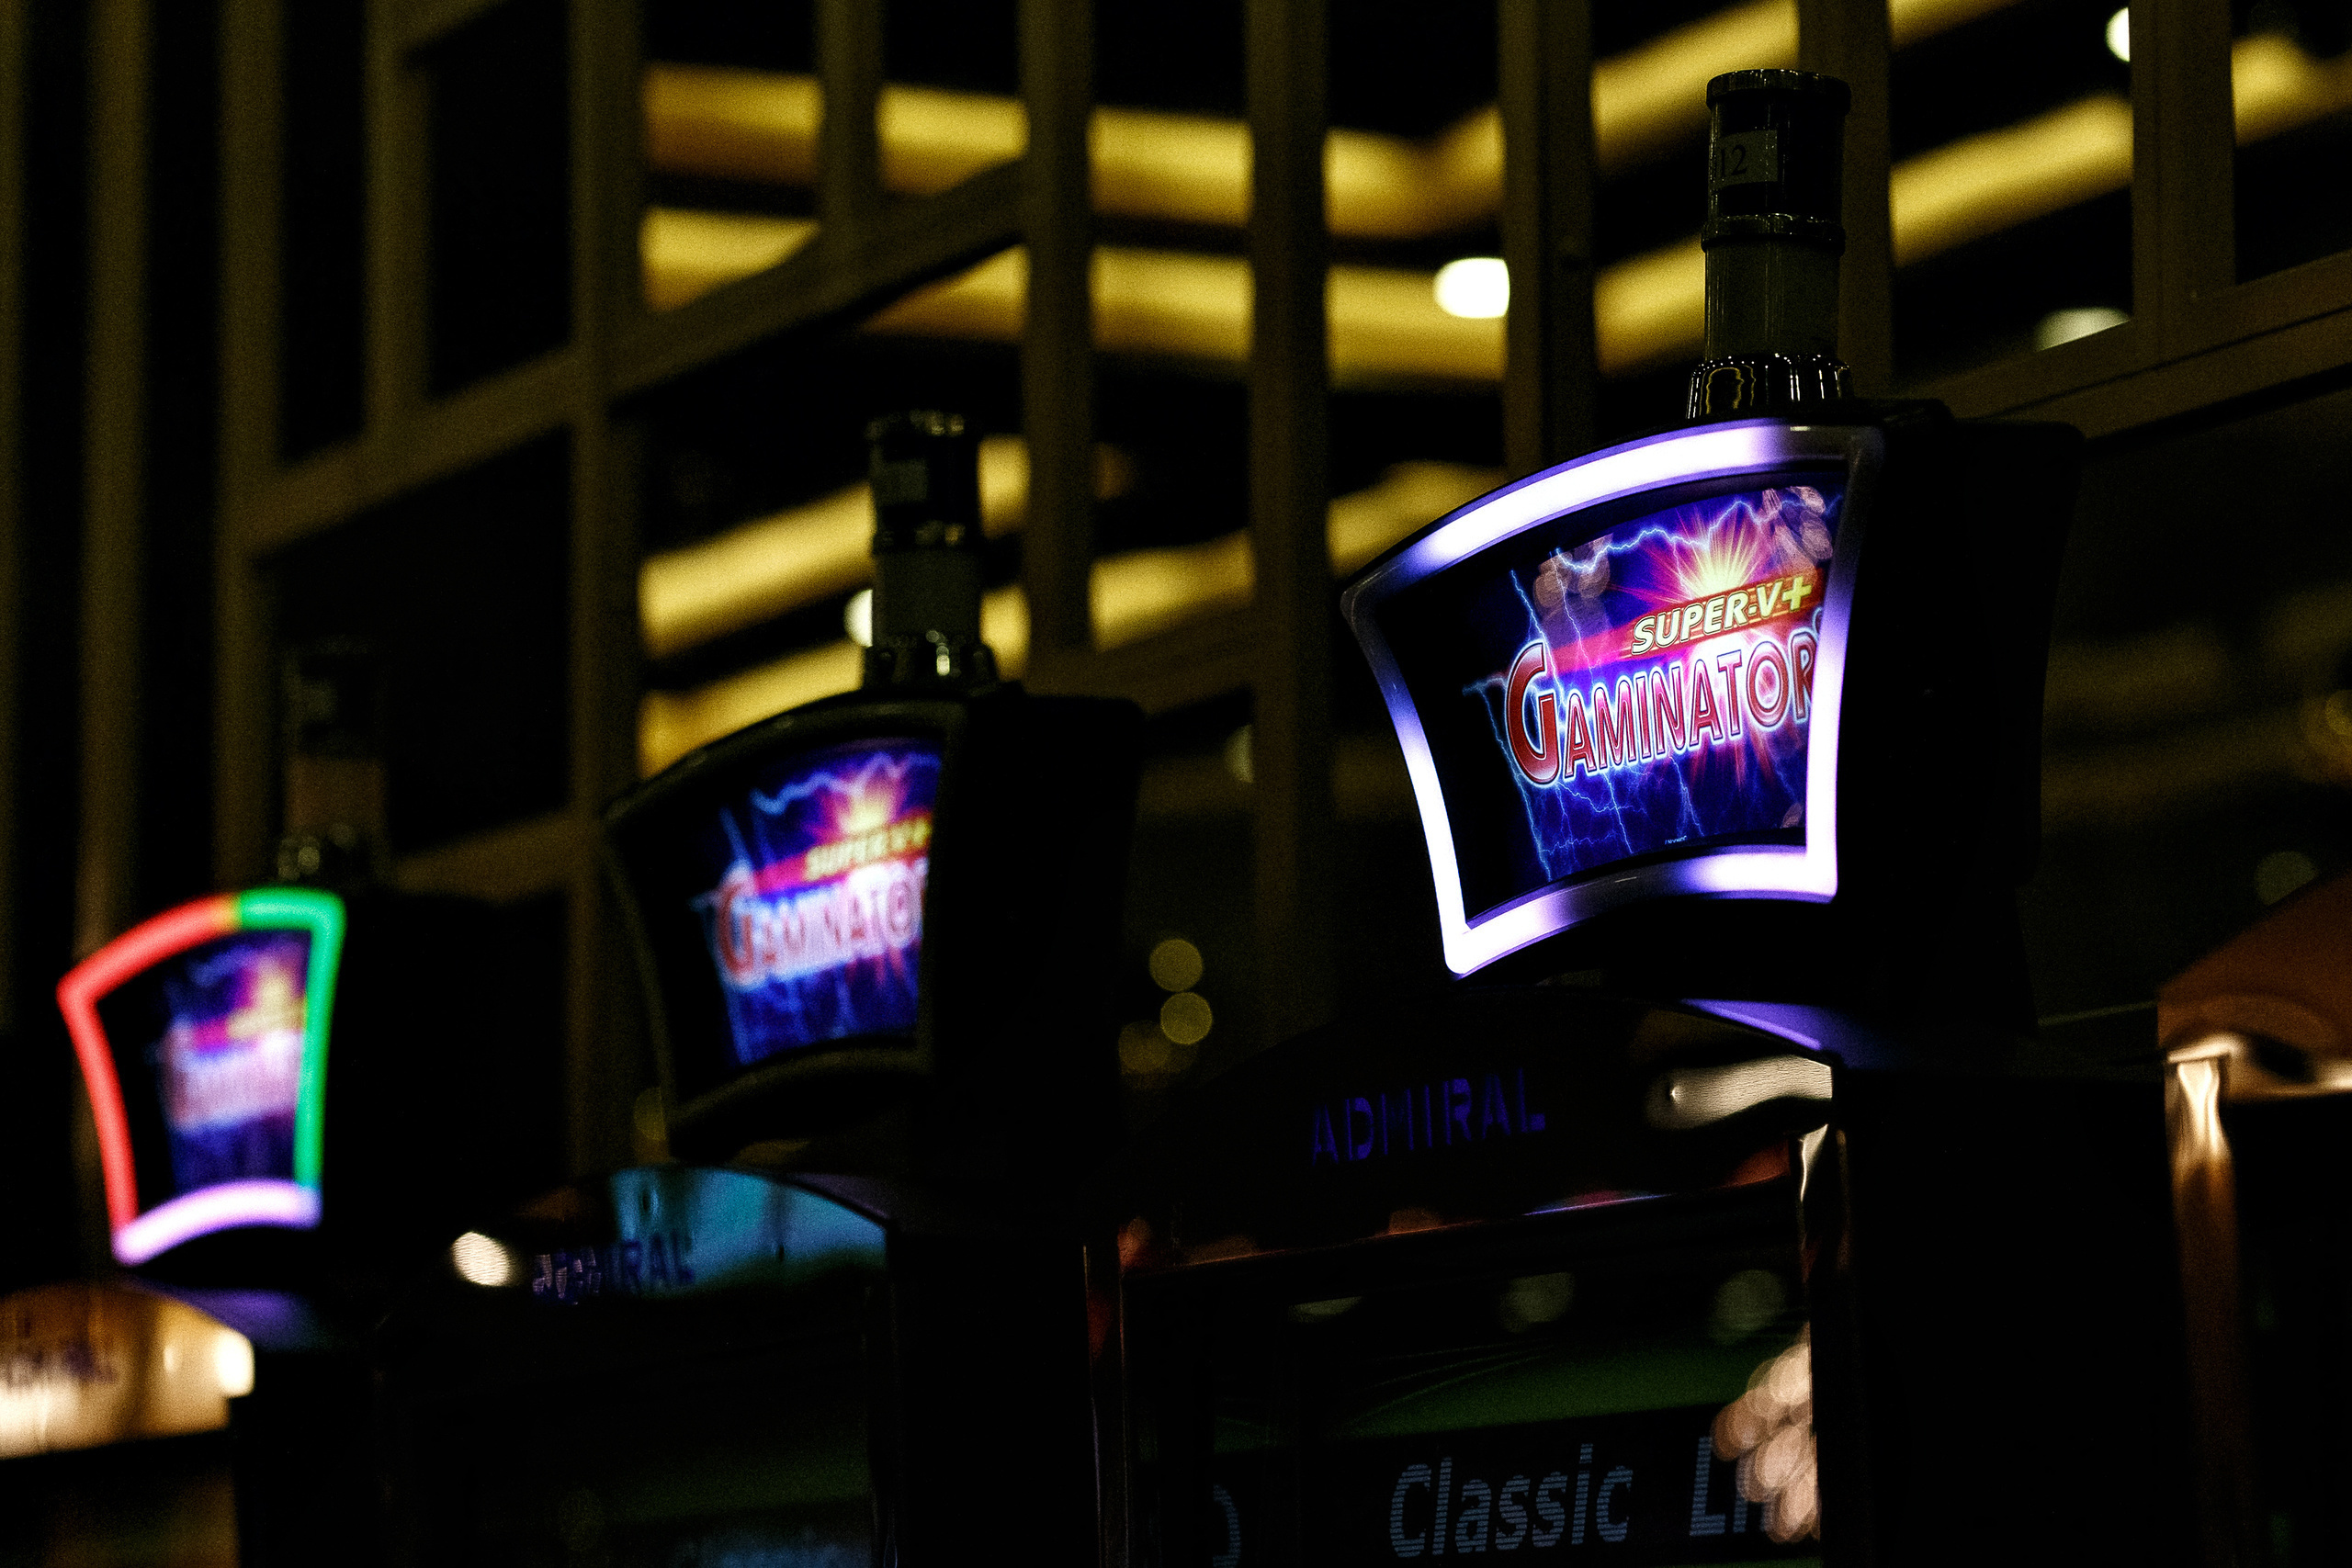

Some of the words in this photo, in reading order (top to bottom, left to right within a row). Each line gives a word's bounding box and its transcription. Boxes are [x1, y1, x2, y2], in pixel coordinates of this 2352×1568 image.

[1506, 631, 1818, 786] GAMINATOR
[1311, 1066, 1547, 1168] ADMIRAL
[1389, 1442, 1634, 1559] Classic
